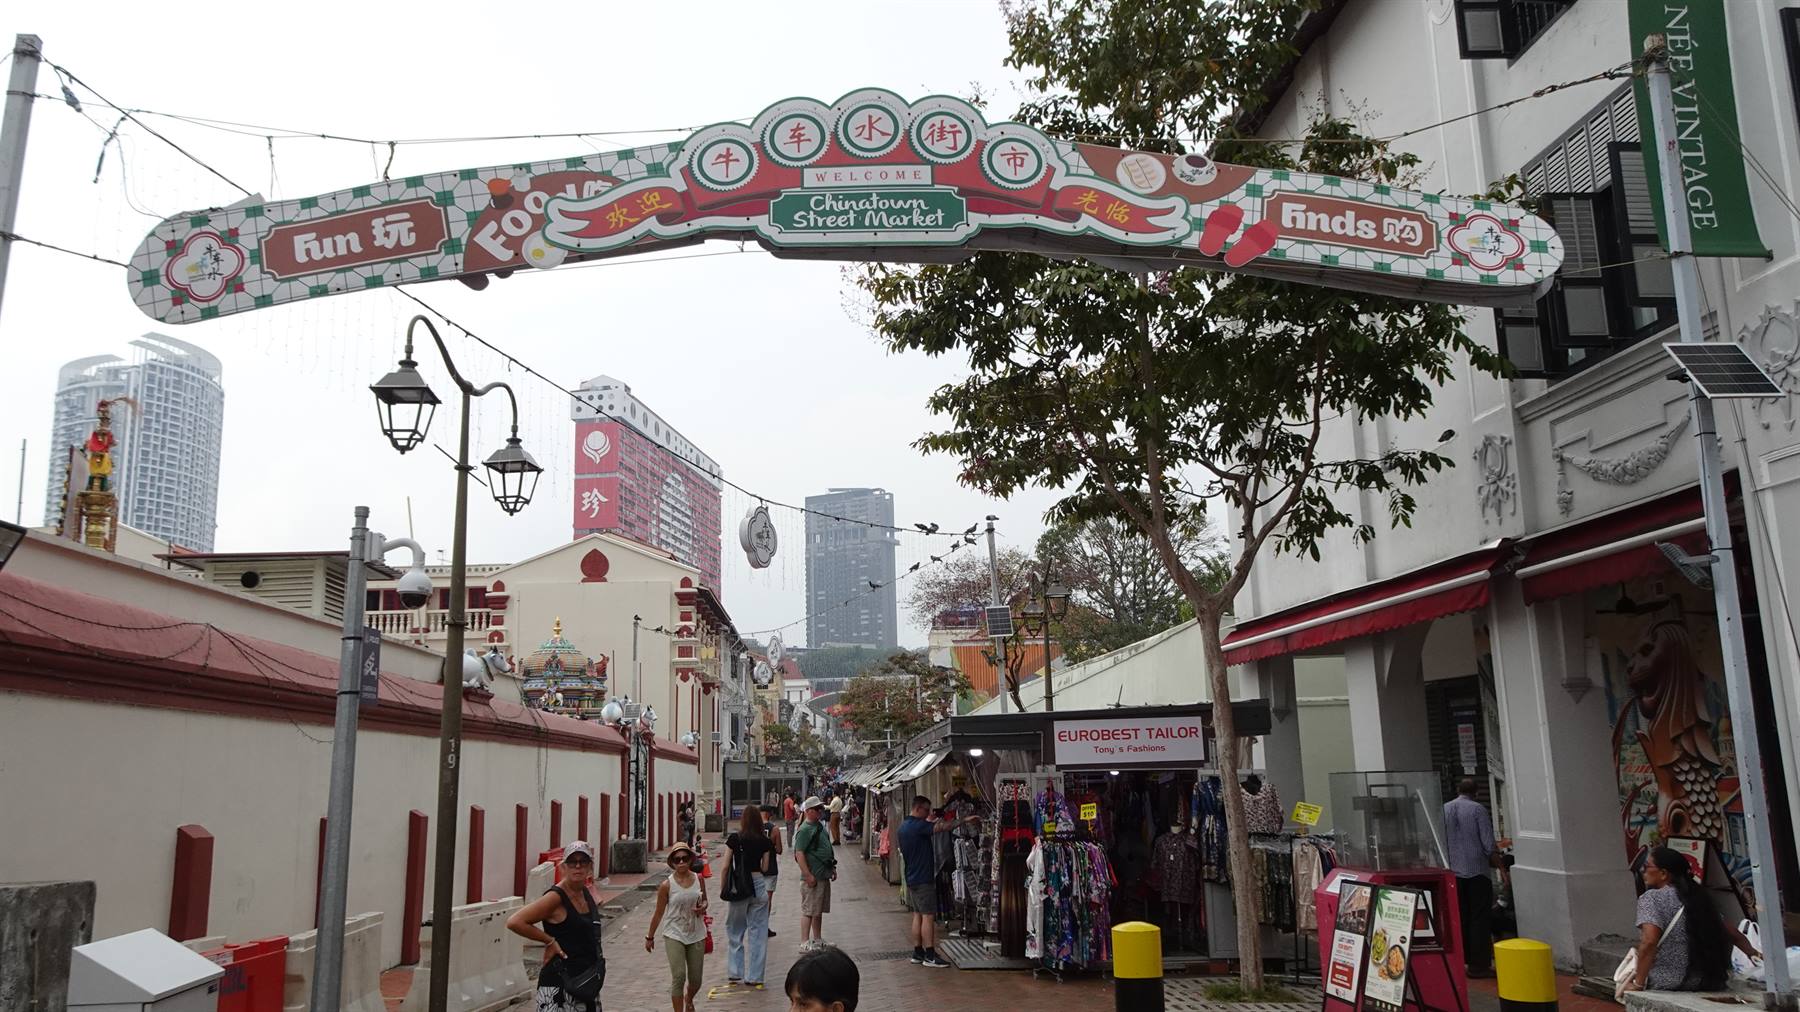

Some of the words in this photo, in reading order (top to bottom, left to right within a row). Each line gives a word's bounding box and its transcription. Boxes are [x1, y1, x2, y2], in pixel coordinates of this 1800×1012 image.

[1664, 5, 1698, 73] NÉE
[711, 114, 1029, 178] 牛车水街市
[1671, 79, 1719, 230] VINTAGE
[815, 170, 922, 182] WELCOME
[605, 191, 673, 230] 欢迎
[810, 193, 929, 211] Chinatown
[1073, 190, 1130, 224] 光临
[371, 212, 416, 249] 玩
[793, 210, 857, 228] Street
[864, 208, 945, 228] Market
[1382, 216, 1424, 247] 购
[581, 488, 608, 519] 珍
[1058, 728, 1141, 742] EUROBEST
[1145, 726, 1200, 739] TAILOR
[1127, 744, 1166, 752] Fashions
